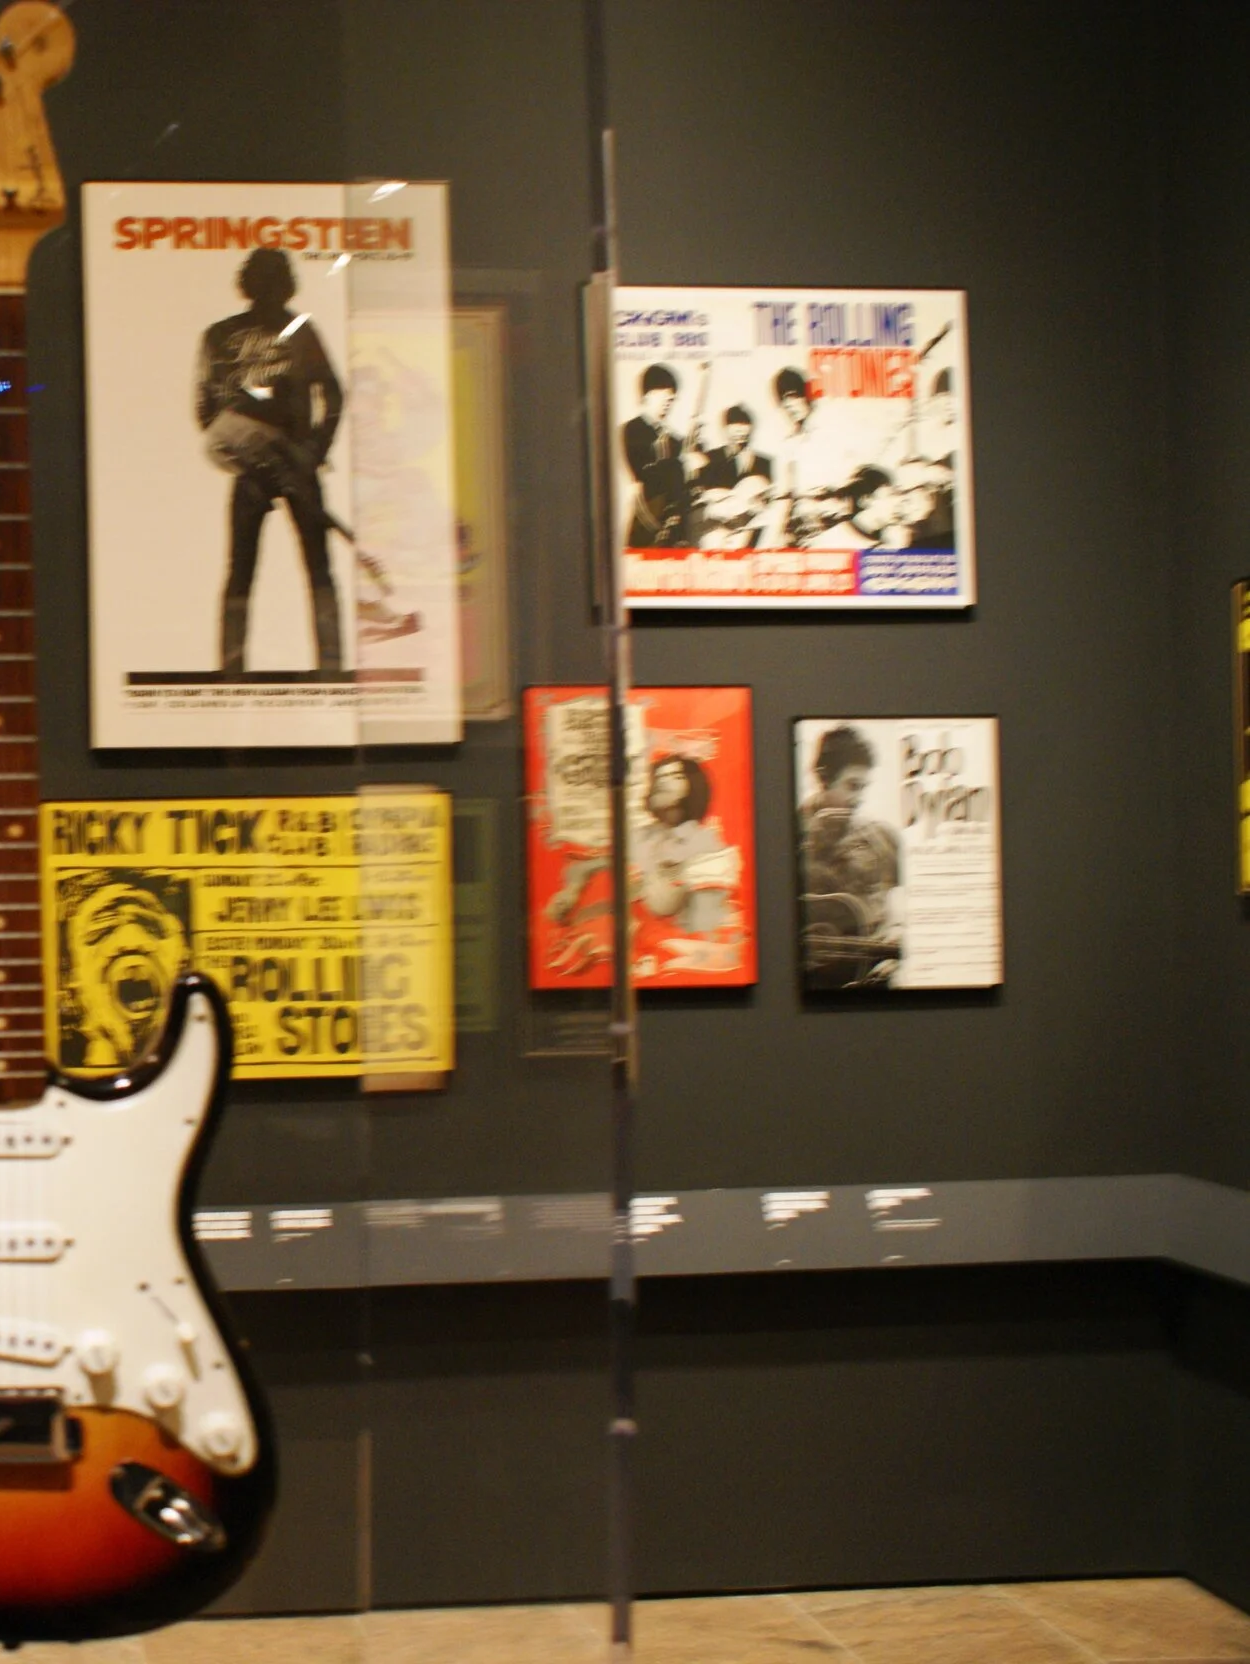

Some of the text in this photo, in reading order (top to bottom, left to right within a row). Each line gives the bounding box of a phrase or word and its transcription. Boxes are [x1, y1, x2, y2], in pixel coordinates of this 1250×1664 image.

[115, 216, 415, 250] SPRINGSTEEN
[751, 302, 798, 346] THE
[806, 302, 916, 347] ROLLING
[52, 809, 267, 855] RICKY TICK
[216, 896, 291, 922] JERRY
[302, 896, 344, 922] LEE
